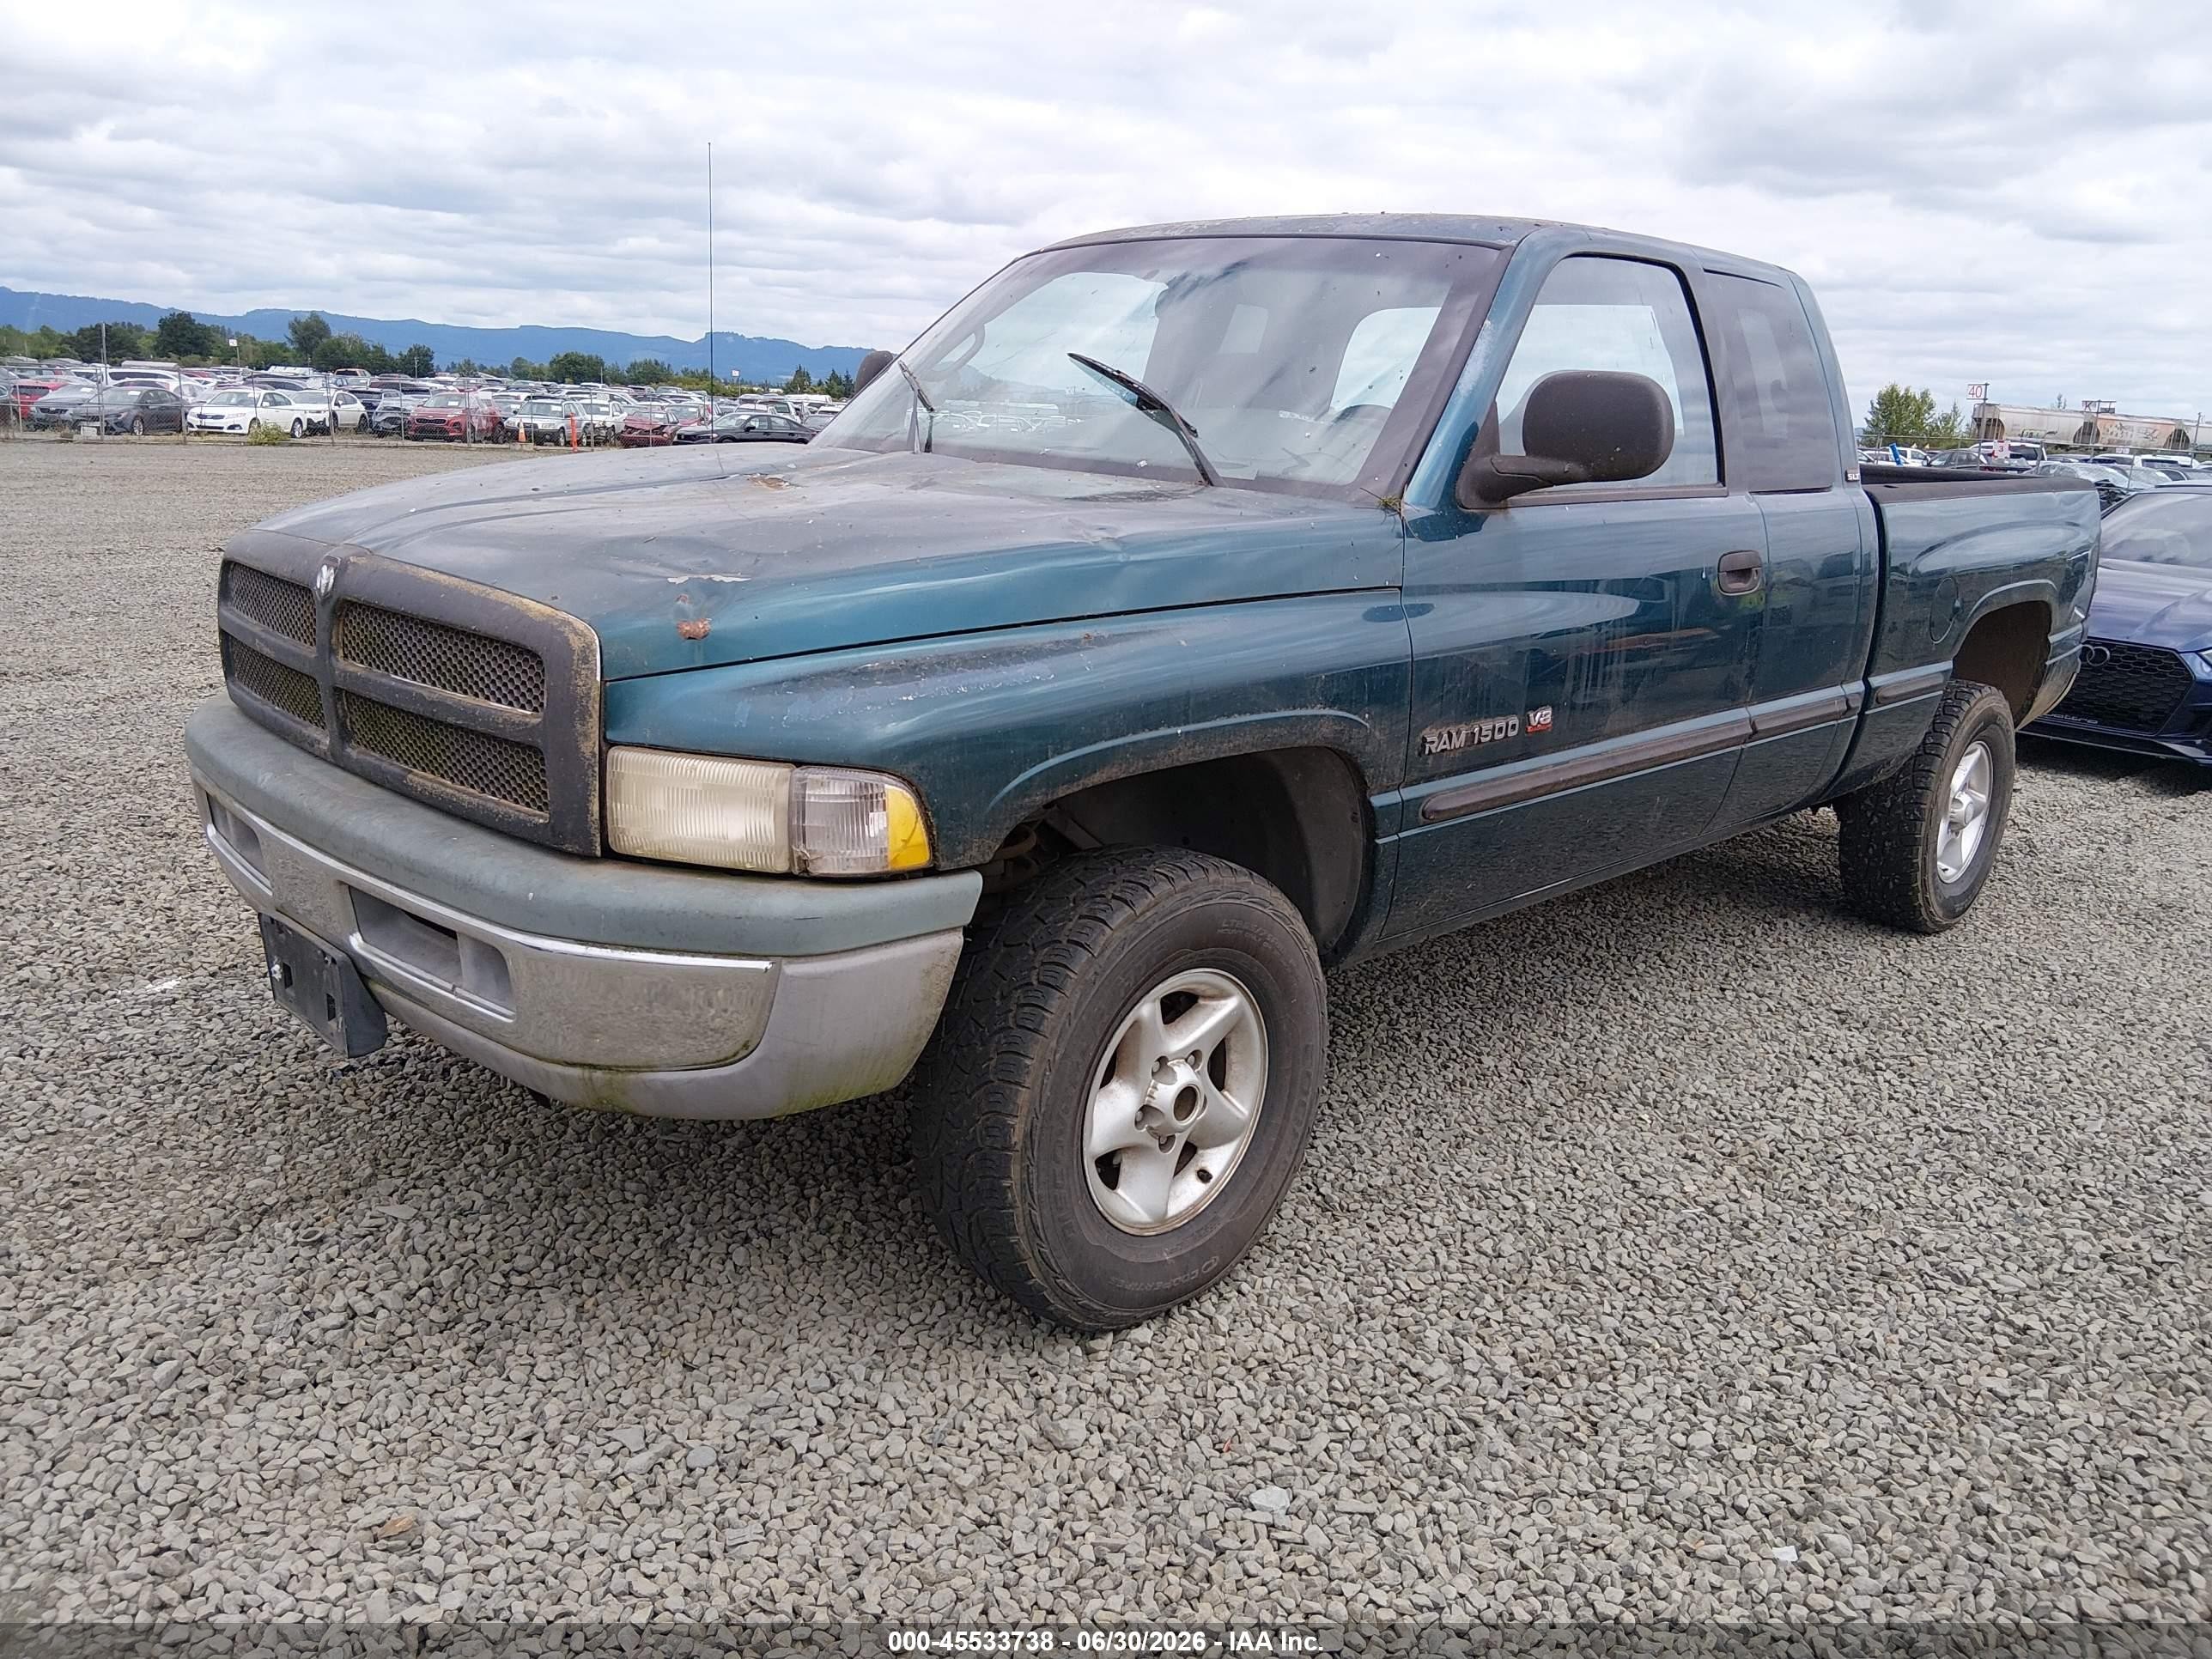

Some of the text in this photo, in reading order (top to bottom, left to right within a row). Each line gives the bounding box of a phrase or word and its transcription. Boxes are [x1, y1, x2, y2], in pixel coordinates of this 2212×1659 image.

[1968, 385, 1983, 398] 40
[1847, 472, 1860, 481] SLT
[1423, 729, 1467, 756] RAM
[1473, 718, 1520, 745] 1500
[1528, 708, 1553, 726] V8
